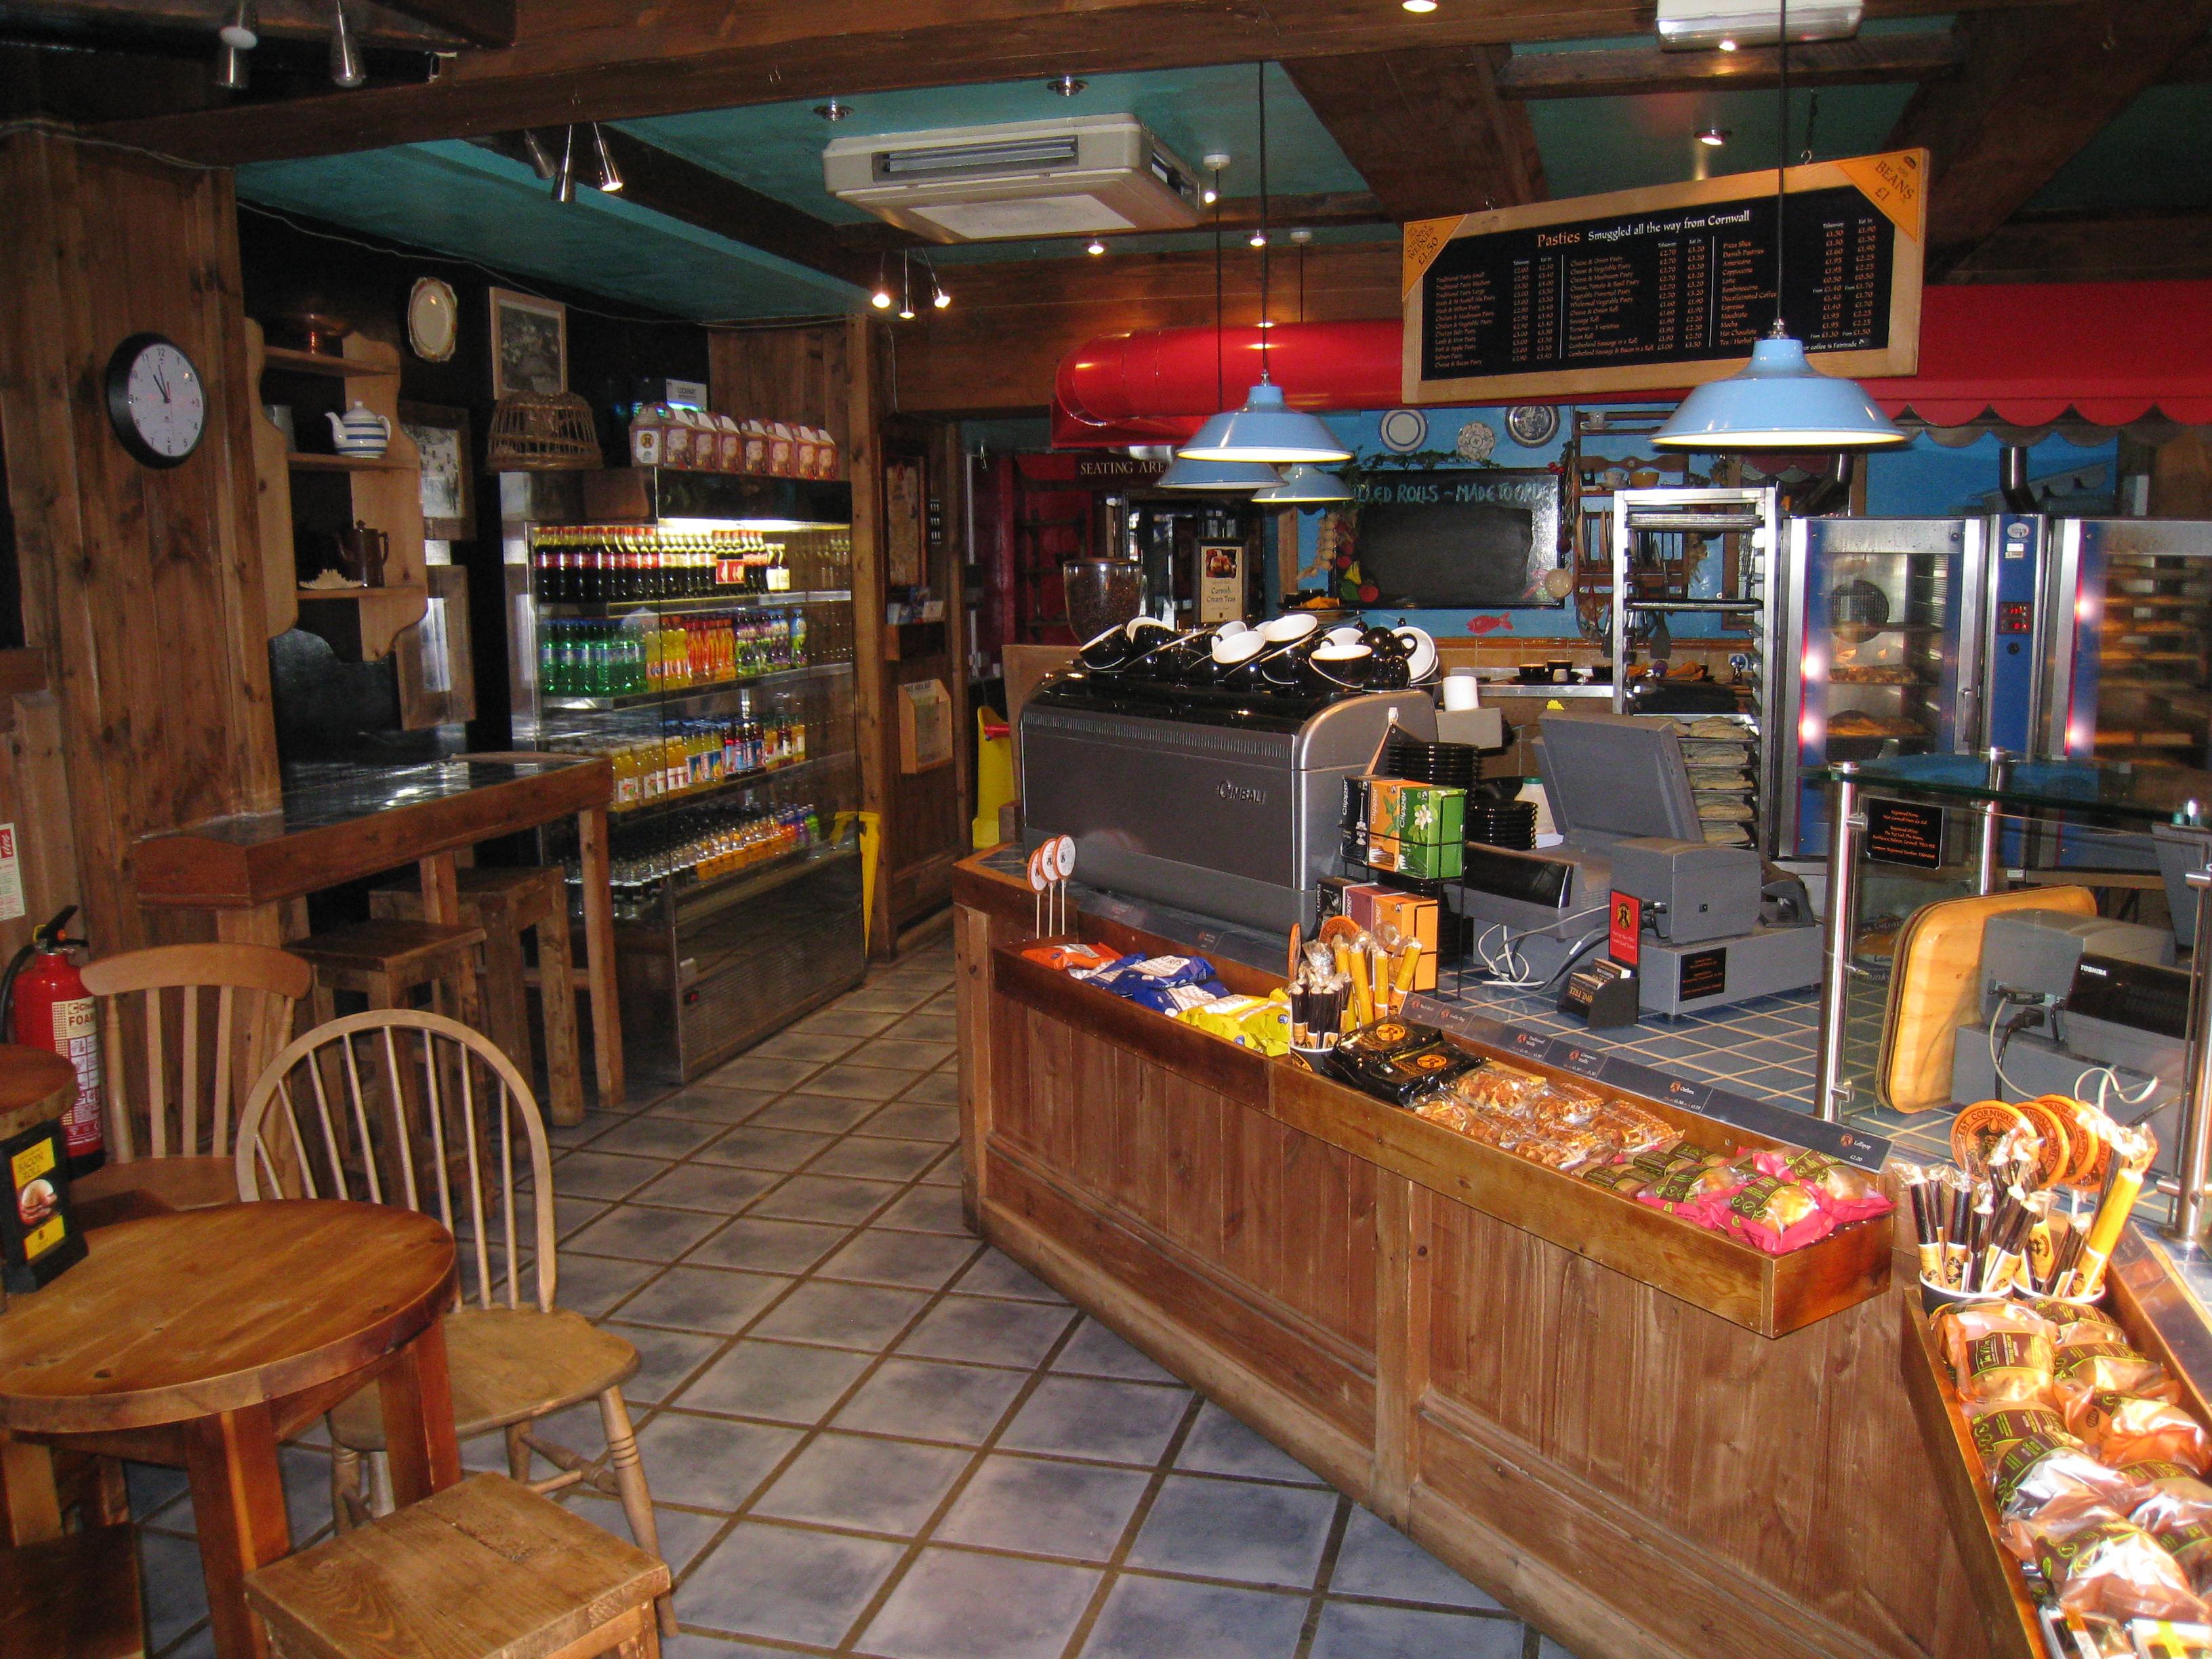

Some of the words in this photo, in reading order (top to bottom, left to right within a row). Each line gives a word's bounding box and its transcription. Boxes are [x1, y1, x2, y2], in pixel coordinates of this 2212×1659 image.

[1876, 161, 1914, 199] BEANS
[1537, 231, 1581, 247] Pasties
[1588, 224, 1631, 242] Smuggled
[1633, 223, 1644, 235] all
[1647, 222, 1661, 233] the
[1663, 222, 1681, 234] way
[1683, 216, 1705, 229] from
[1707, 210, 1750, 226] Cornwall
[1418, 237, 1438, 266] £1.50
[142, 353, 149, 362] 11
[157, 348, 165, 356] 12
[189, 373, 193, 382] 2
[195, 398, 200, 407] 3
[194, 422, 199, 431] 4
[167, 444, 171, 454] 6
[184, 438, 188, 447] 5
[1080, 462, 1133, 475] SEATING
[1397, 484, 1439, 504] ROLLS
[1456, 483, 1495, 502] MADE
[1498, 482, 1513, 501] TO
[1211, 586, 1231, 594] Cornish
[1341, 775, 1349, 816] Clipper
[1399, 790, 1408, 828] Clipper
[2080, 964, 2107, 977] TOSHIBA
[1569, 986, 1581, 999] FREE
[1971, 1109, 2017, 1128] CORNWAL
[1853, 1140, 1872, 1151] Lollipop
